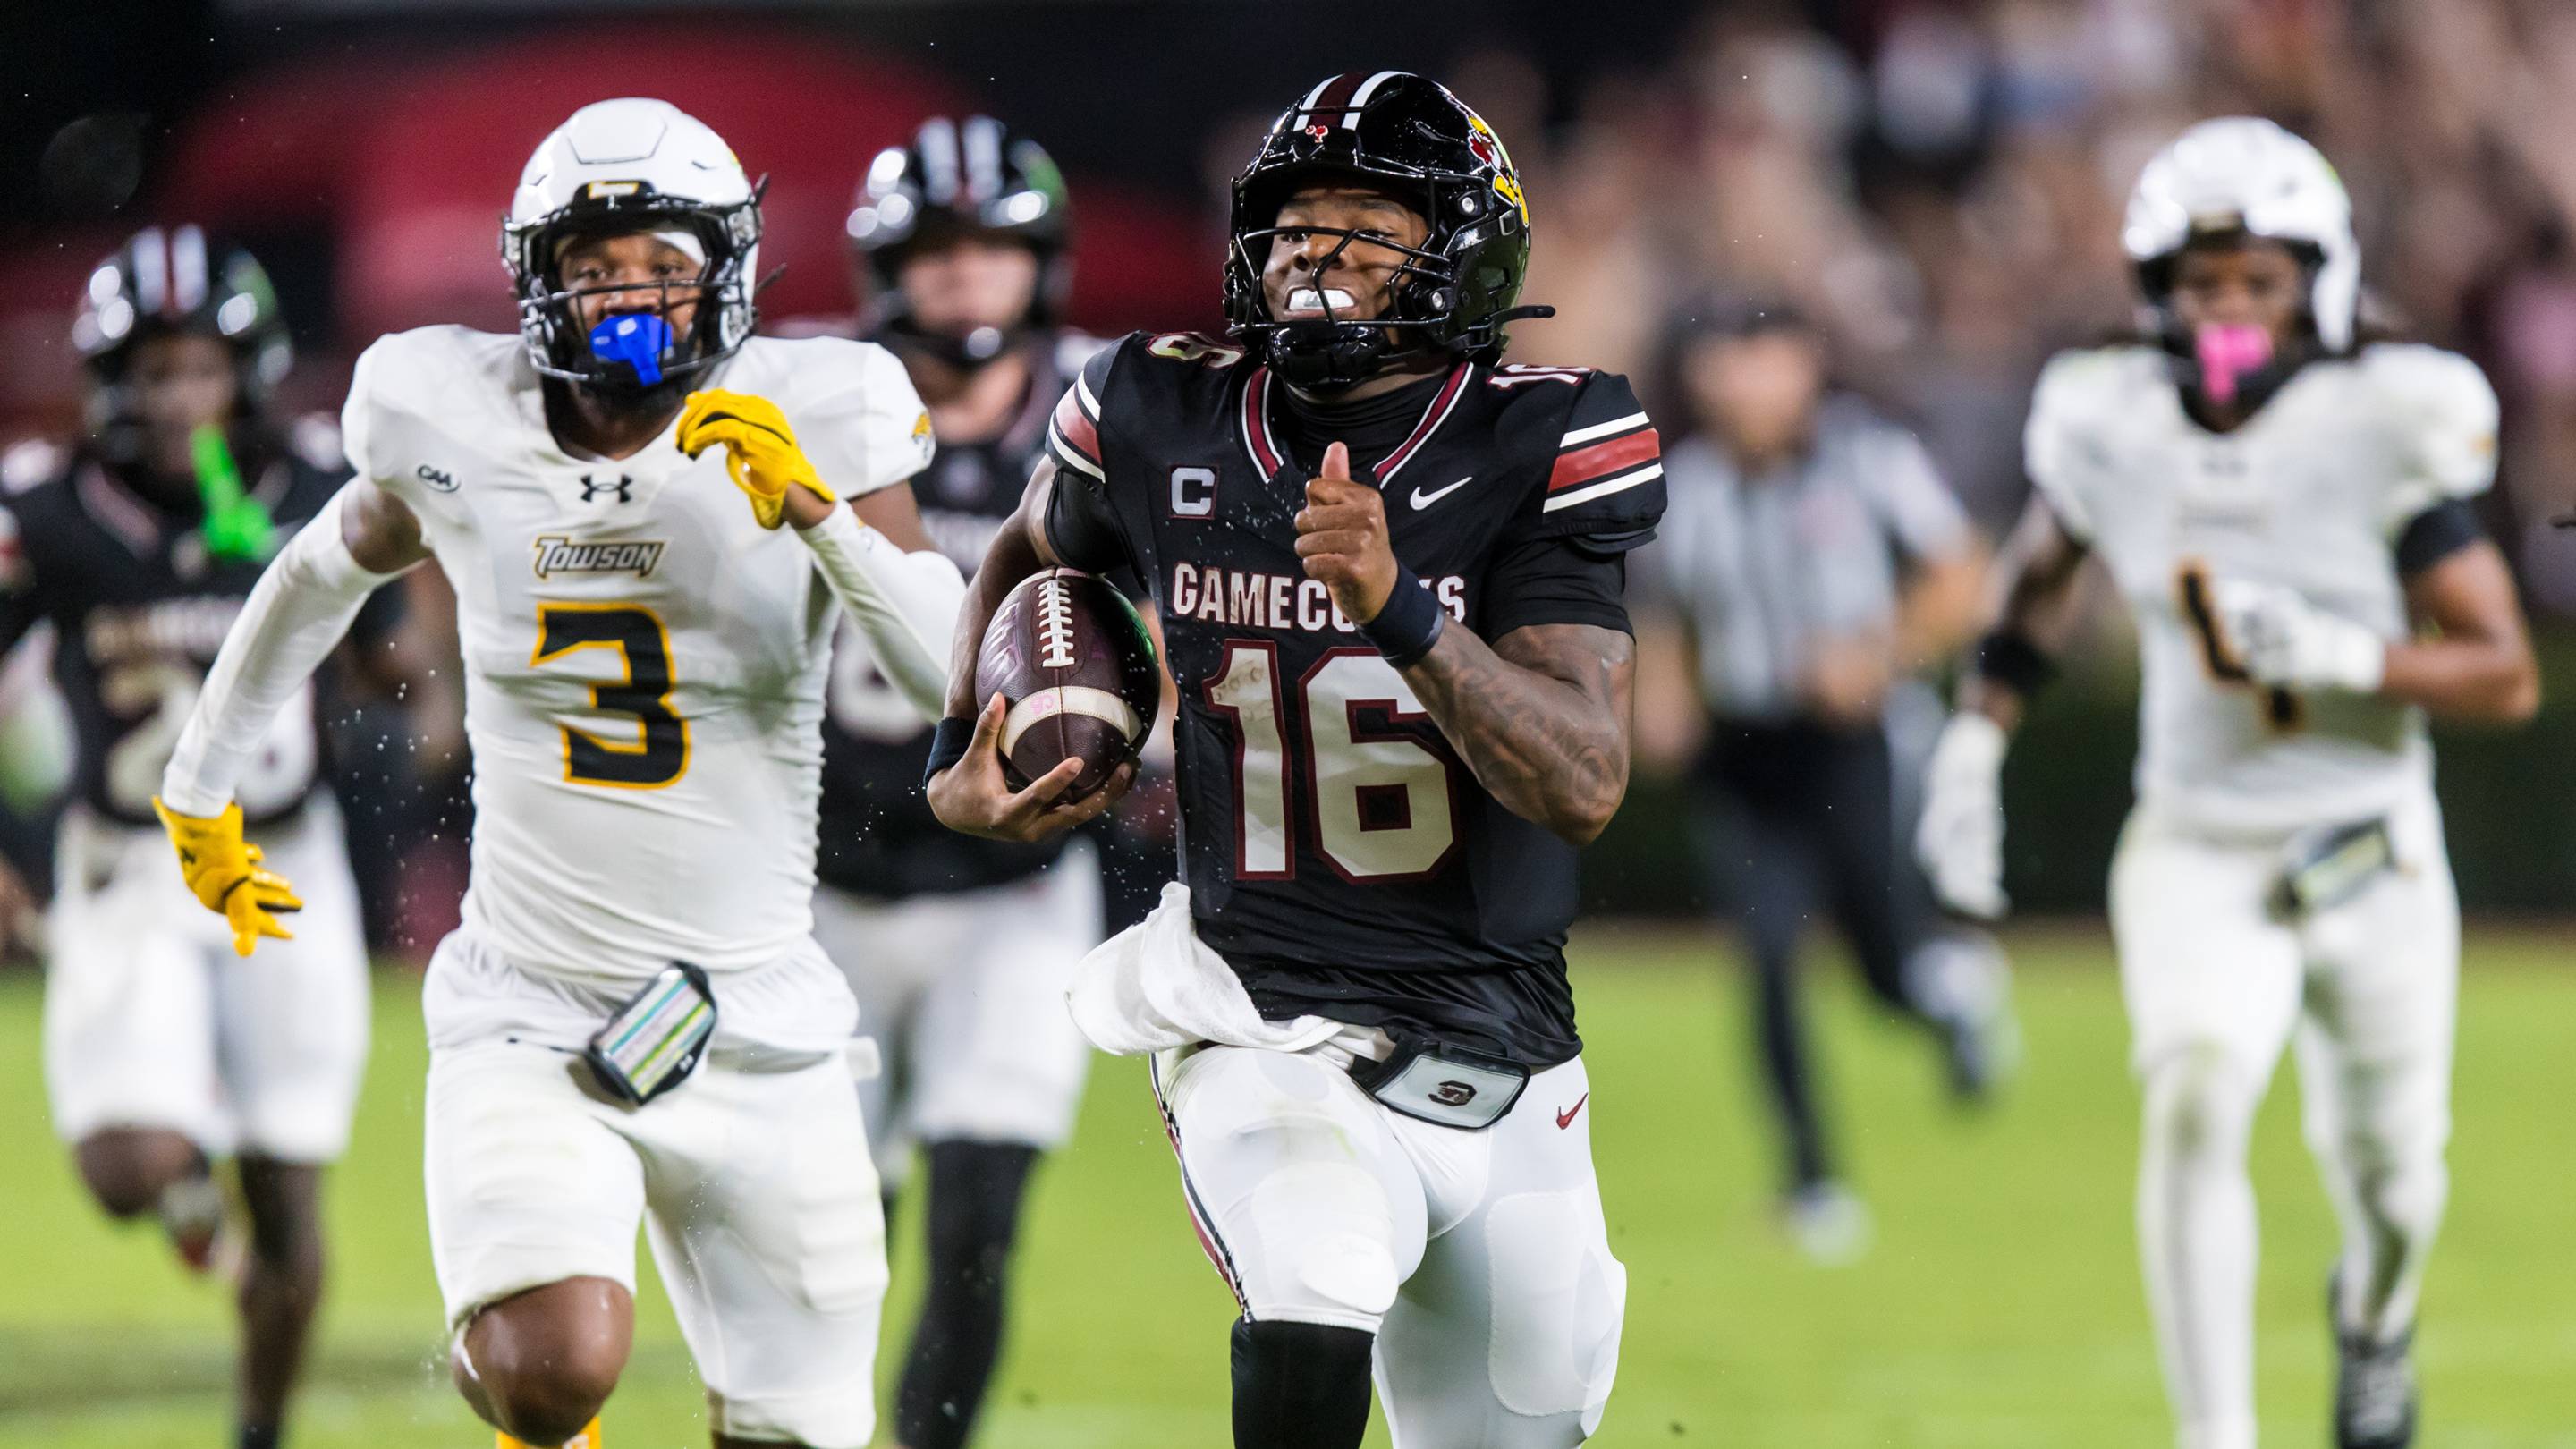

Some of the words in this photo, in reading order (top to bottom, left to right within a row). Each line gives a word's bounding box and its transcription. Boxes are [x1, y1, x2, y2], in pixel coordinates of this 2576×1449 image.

[417, 464, 453, 487] CAA
[1170, 467, 1216, 516] C
[530, 601, 691, 790] 3
[1202, 638, 1462, 886] 16
